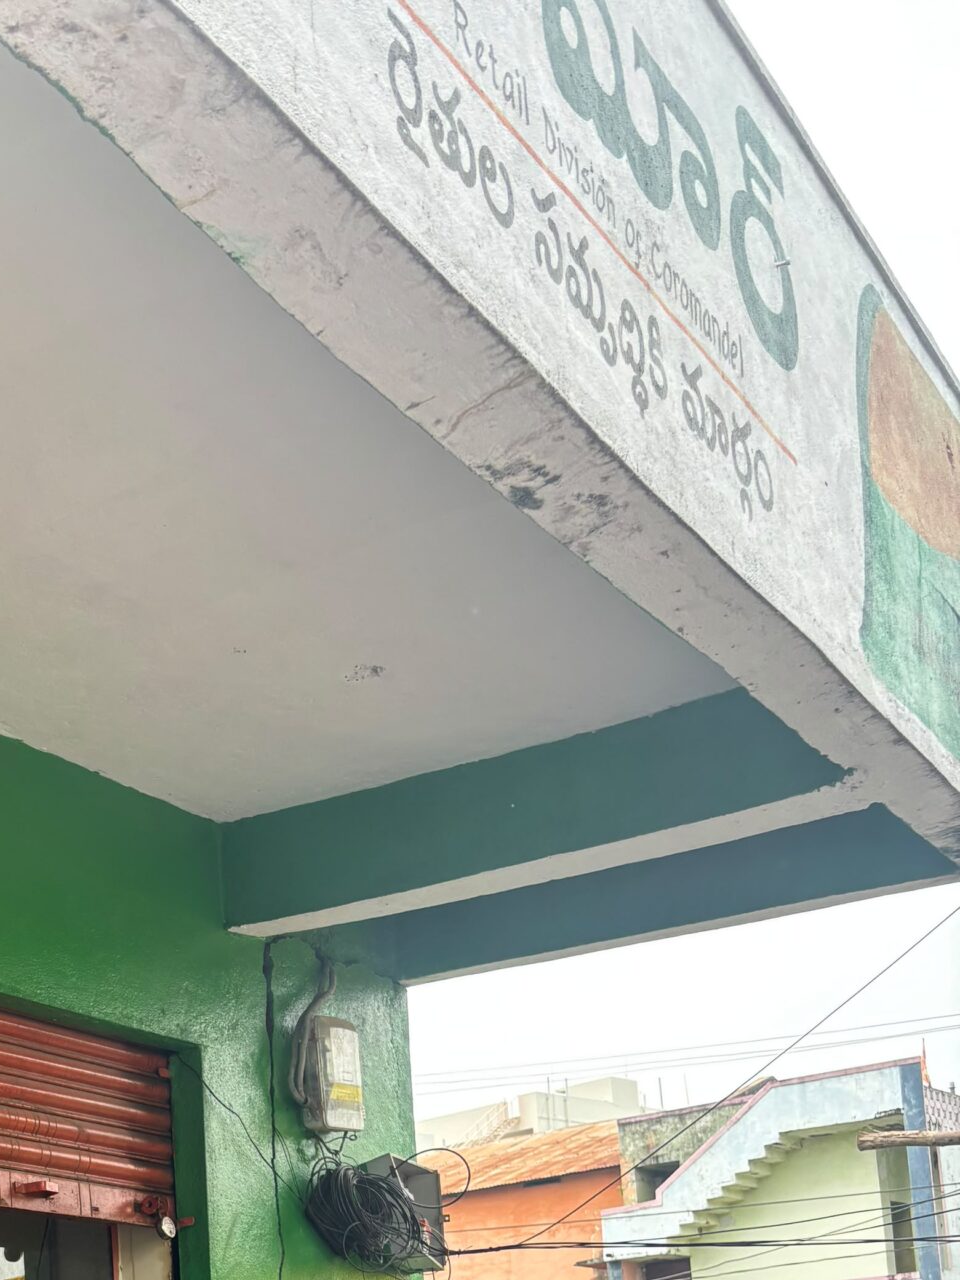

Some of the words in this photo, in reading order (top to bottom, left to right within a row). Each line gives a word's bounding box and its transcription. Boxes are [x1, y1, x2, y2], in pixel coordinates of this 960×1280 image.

[387, 7, 515, 229] రైతుల
[681, 362, 774, 522] మార్గం
[453, 0, 530, 126] Retail
[542, 106, 617, 229] Division
[624, 218, 644, 270] of
[650, 241, 744, 378] Coromandel
